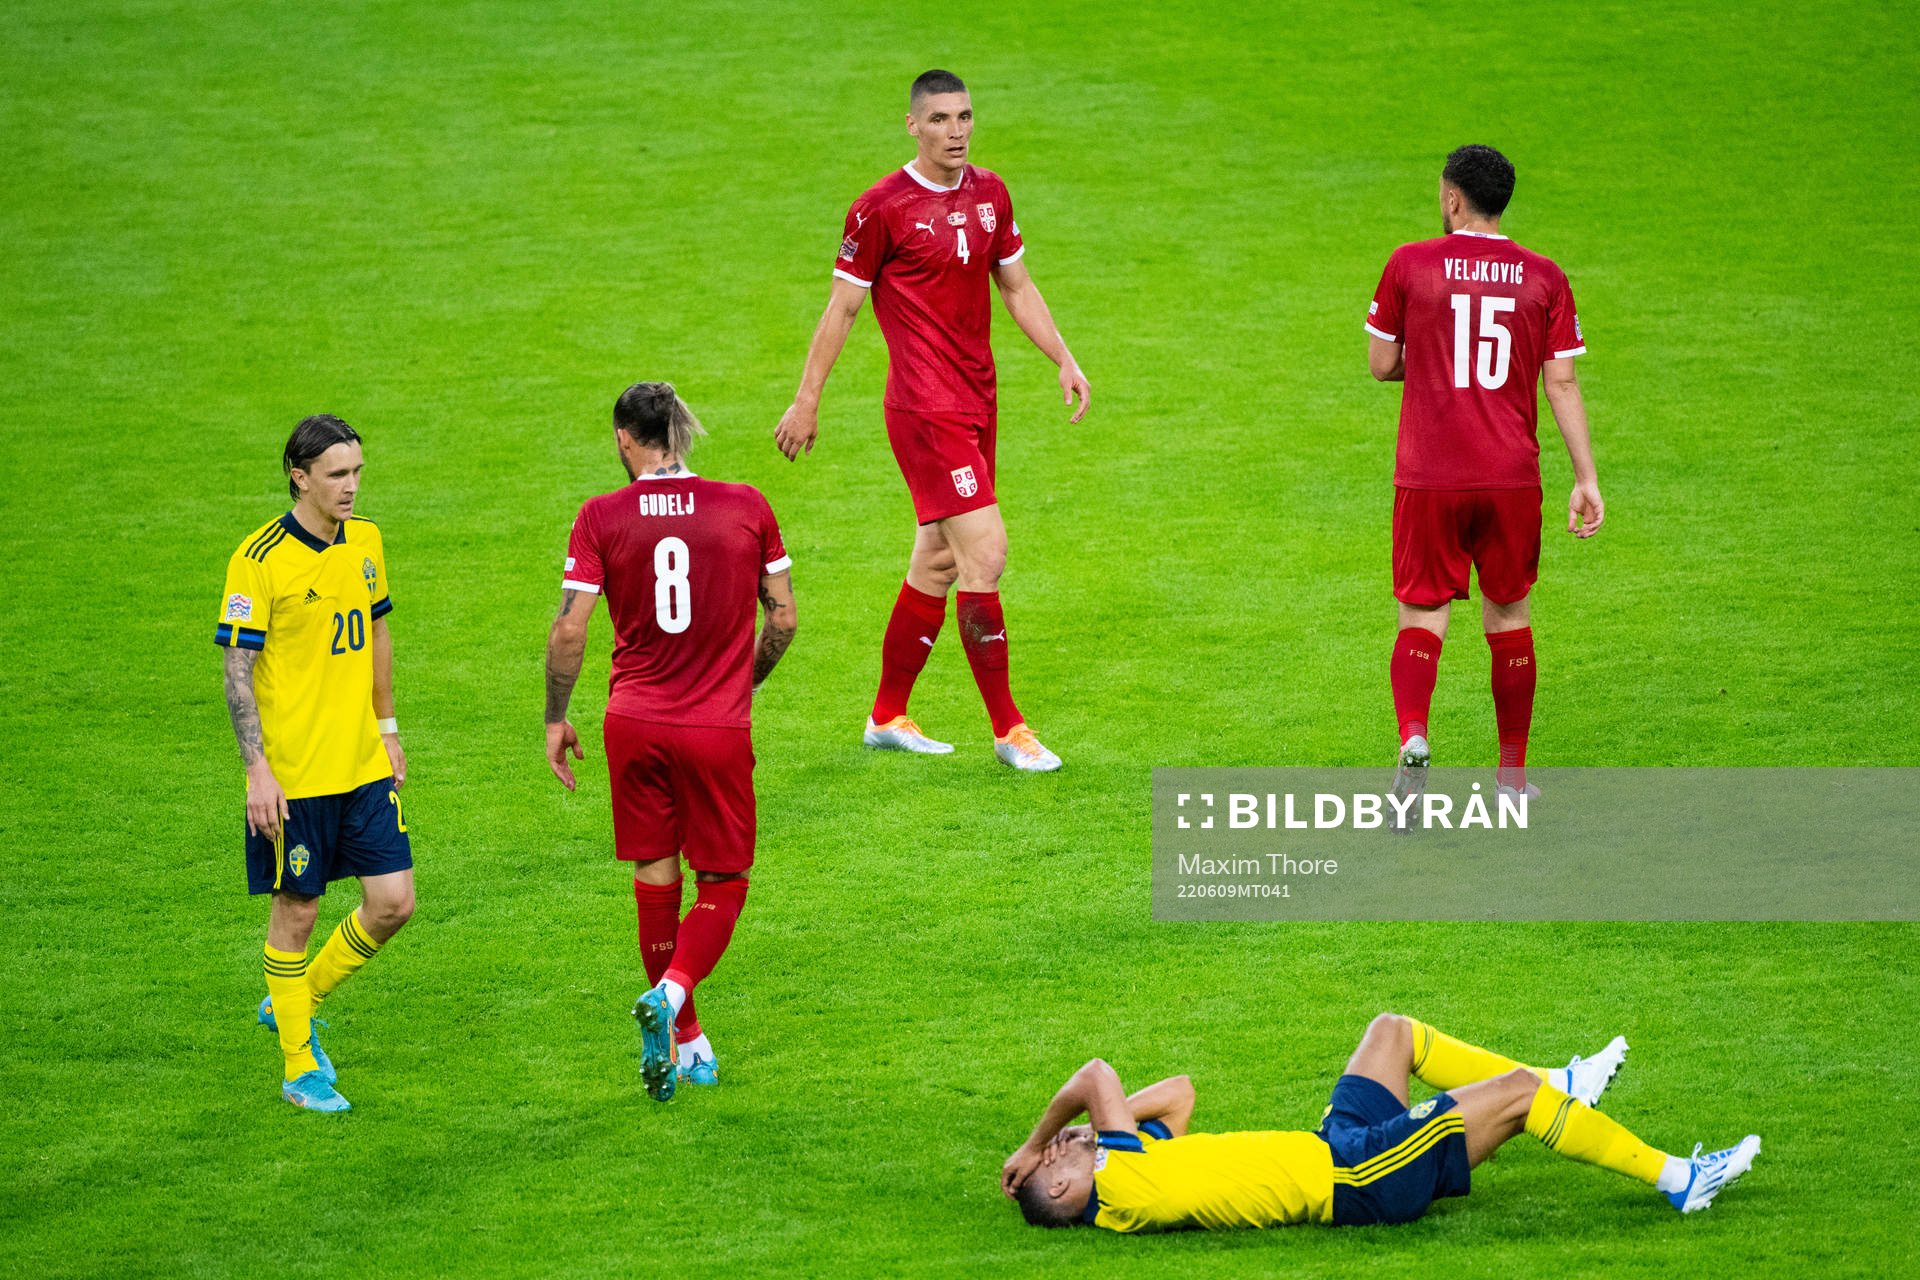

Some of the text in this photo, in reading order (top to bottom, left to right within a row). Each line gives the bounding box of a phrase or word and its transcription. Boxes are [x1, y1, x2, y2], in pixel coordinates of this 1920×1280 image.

[956, 228, 970, 265] 4
[1444, 258, 1524, 285] VELJKOVIĆ
[1450, 293, 1516, 391] 15
[639, 492, 695, 516] GUDELJ
[653, 536, 692, 635] 8
[331, 608, 366, 656] 20
[1509, 656, 1529, 668] FSS
[651, 941, 674, 952] FSS
